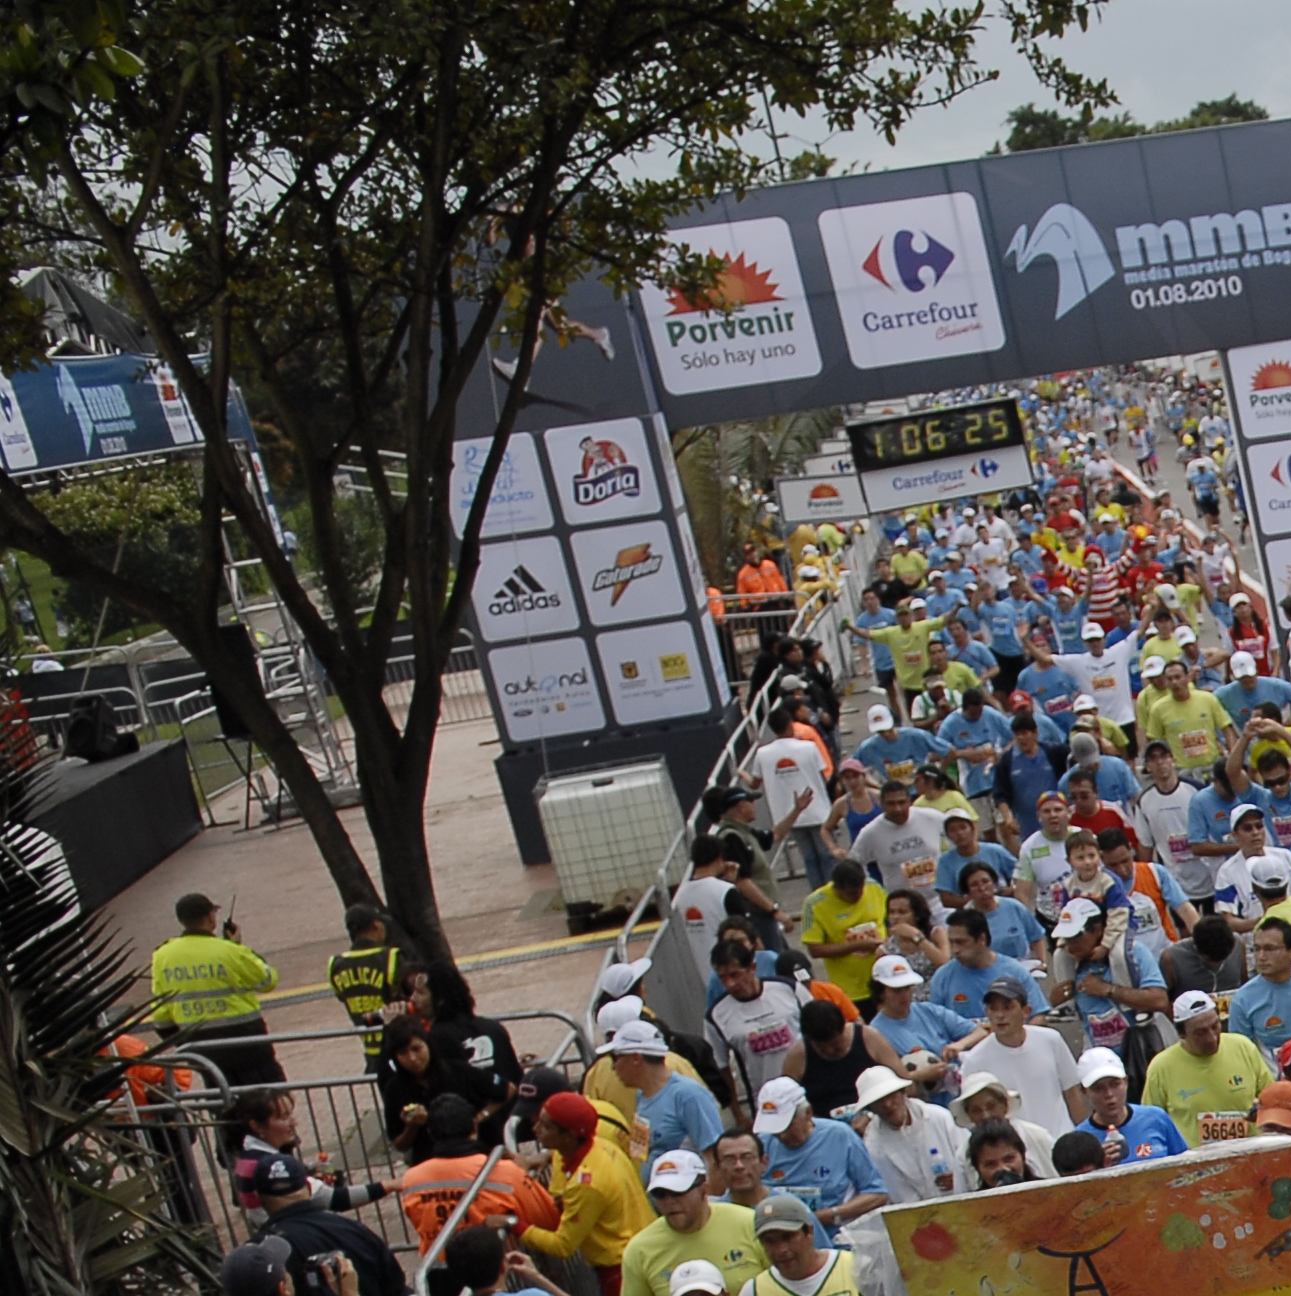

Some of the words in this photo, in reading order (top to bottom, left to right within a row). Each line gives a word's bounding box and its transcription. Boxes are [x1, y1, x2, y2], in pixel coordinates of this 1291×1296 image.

[1124, 265, 1172, 284] media
[1175, 257, 1239, 279] maratón
[1242, 252, 1260, 268] de
[1131, 275, 1243, 309] 01.08.2010
[666, 307, 795, 347] Porvenir
[862, 301, 979, 333] Carrefour
[680, 351, 720, 371] Sólo
[724, 346, 757, 371] hay
[761, 342, 797, 359] uno
[578, 475, 637, 505] Doria
[892, 469, 963, 490] Carrefour
[593, 555, 663, 590] Gatorade
[488, 593, 561, 616] adidas
[163, 963, 228, 983] POLICIA
[333, 966, 384, 991] POLICIA
[1201, 1121, 1245, 1140] 36649
